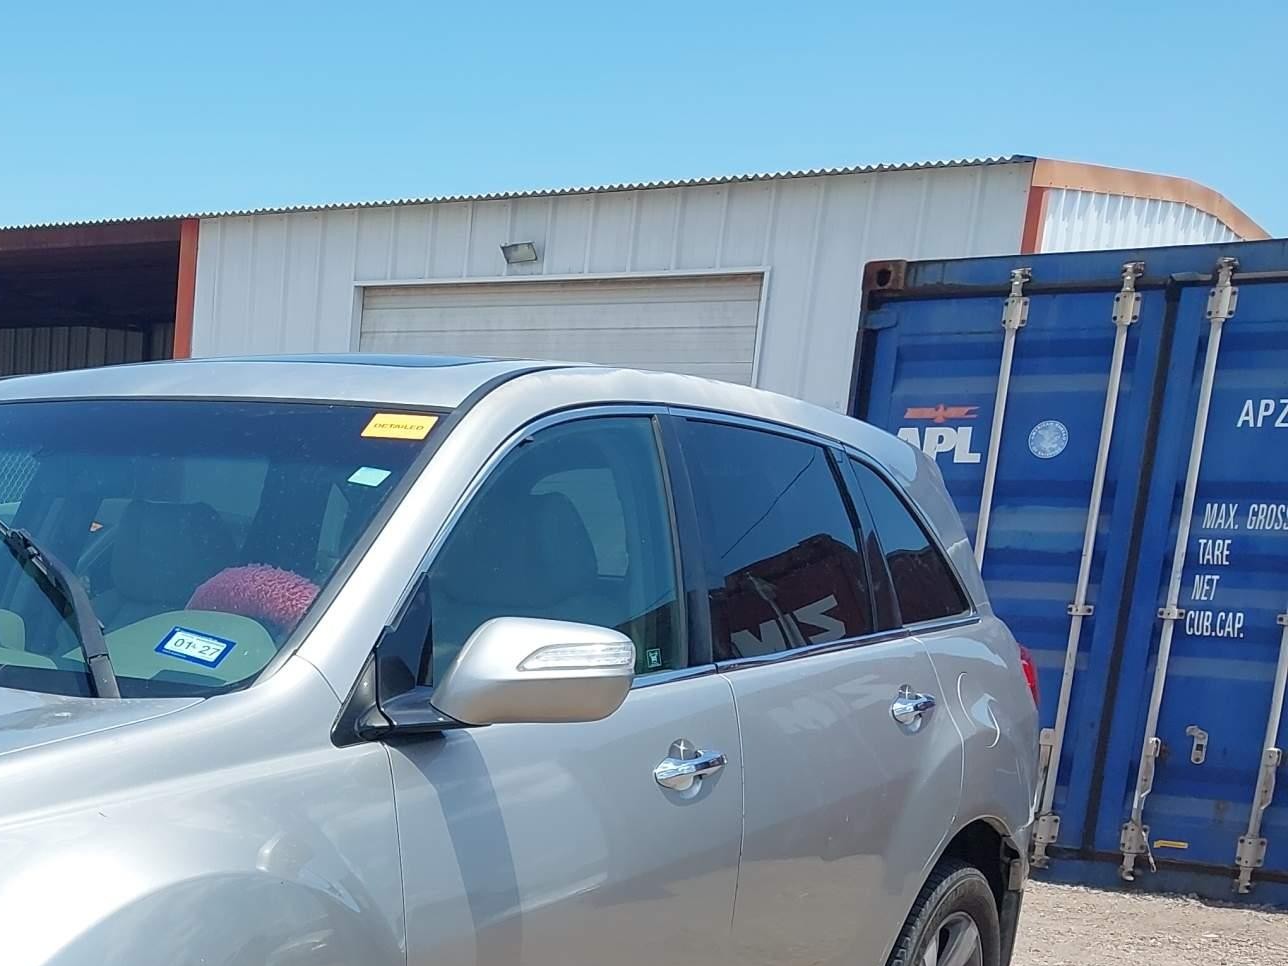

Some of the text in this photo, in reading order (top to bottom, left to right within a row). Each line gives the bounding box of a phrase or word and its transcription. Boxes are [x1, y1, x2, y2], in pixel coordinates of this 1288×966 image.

[1236, 399, 1288, 428] APZ
[896, 427, 981, 464] APL
[1202, 503, 1238, 529] MAX.
[1198, 539, 1232, 565] TARE
[1191, 574, 1220, 601] NET
[1185, 610, 1244, 638] CUB.CAP.
